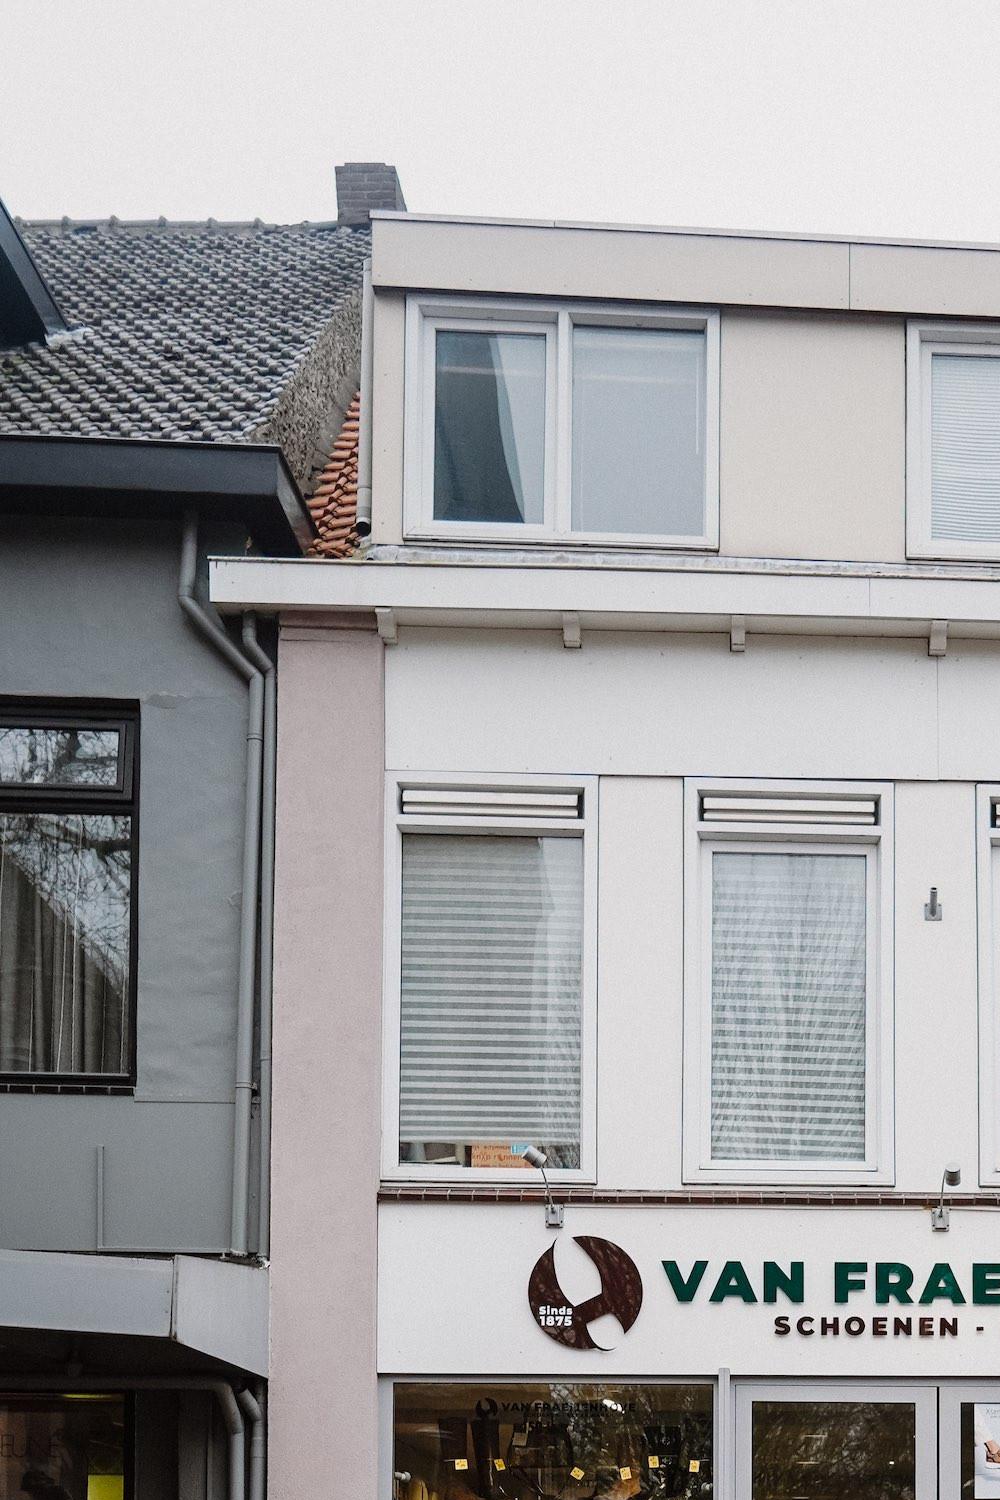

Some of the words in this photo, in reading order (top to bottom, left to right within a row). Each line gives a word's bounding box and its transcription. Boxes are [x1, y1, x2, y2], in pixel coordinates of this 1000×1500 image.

[661, 1260, 805, 1303] VAN
[539, 1305, 573, 1315] Sinds
[540, 1316, 573, 1326] 1875
[774, 1316, 959, 1336] SCHOENEN
[502, 1402, 529, 1412] VAN
